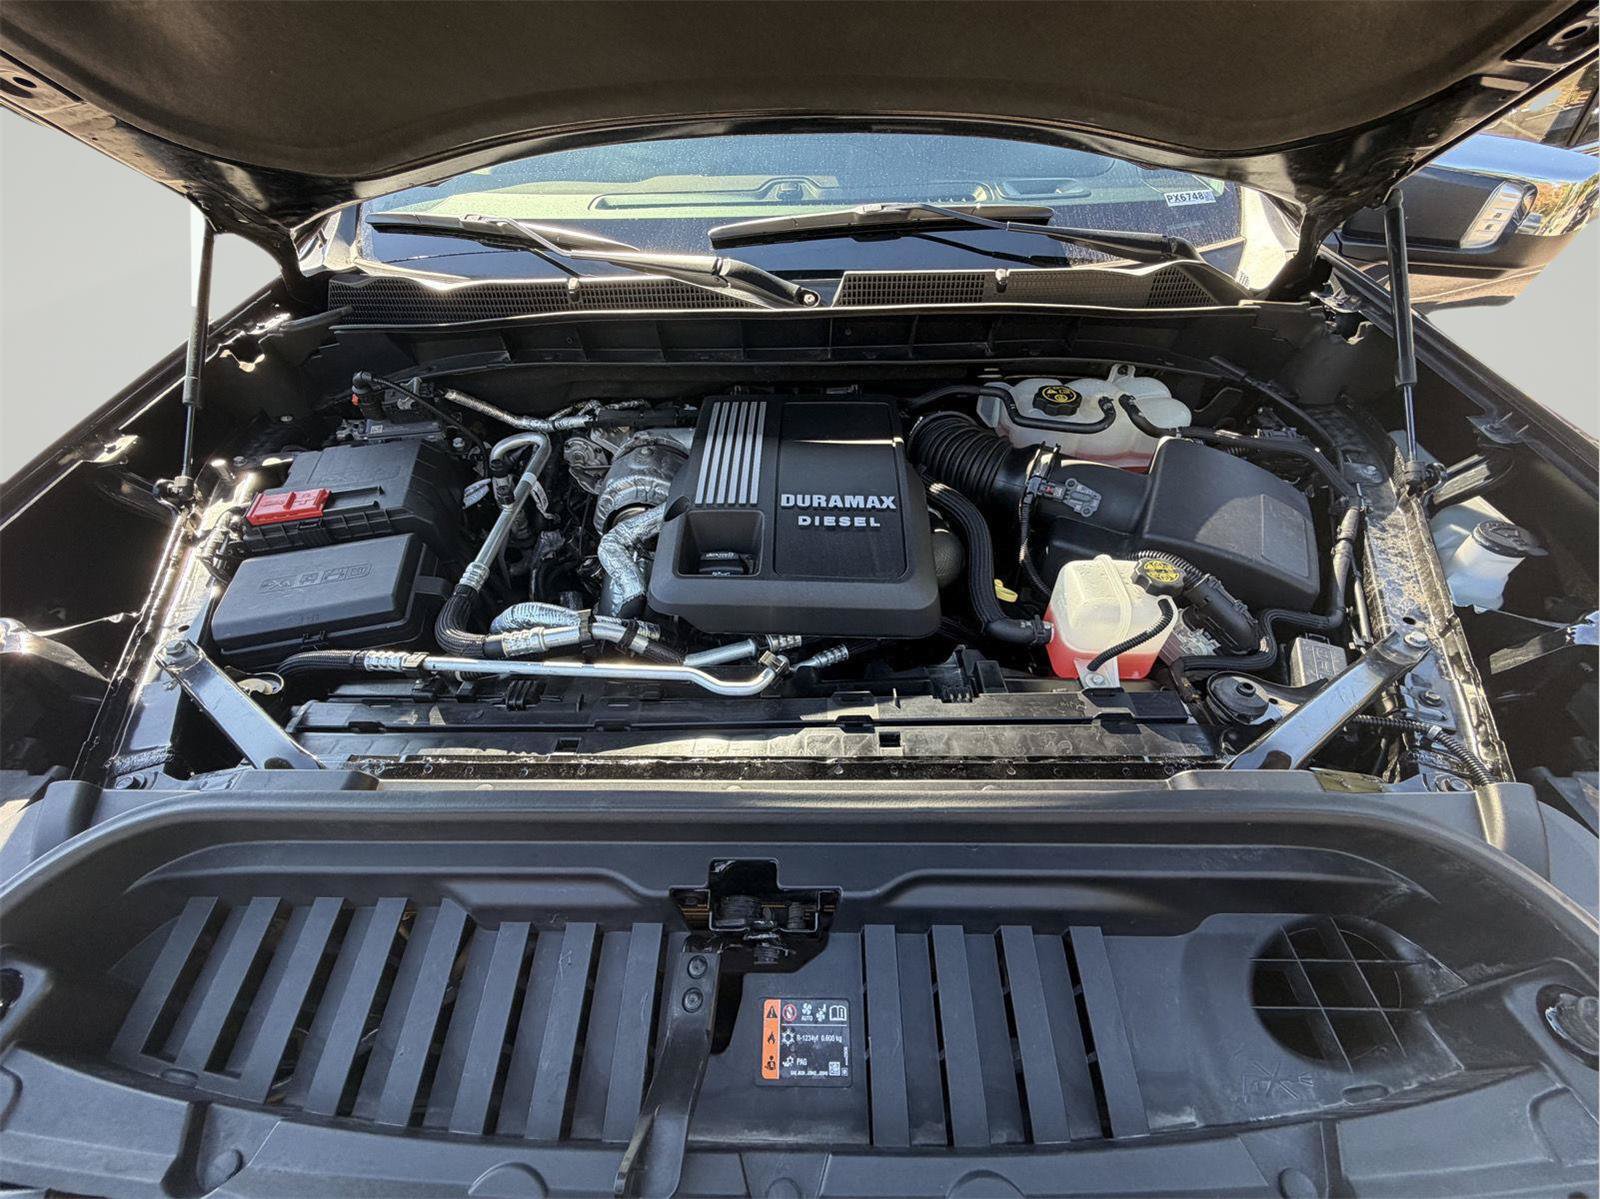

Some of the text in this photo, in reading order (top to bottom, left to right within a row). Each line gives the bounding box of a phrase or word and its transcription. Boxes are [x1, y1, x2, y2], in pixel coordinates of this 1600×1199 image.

[1166, 191, 1204, 203] PX6748
[781, 494, 896, 509] DURAMAX
[798, 515, 881, 527] DIESEL
[796, 1057, 808, 1066] PAG
